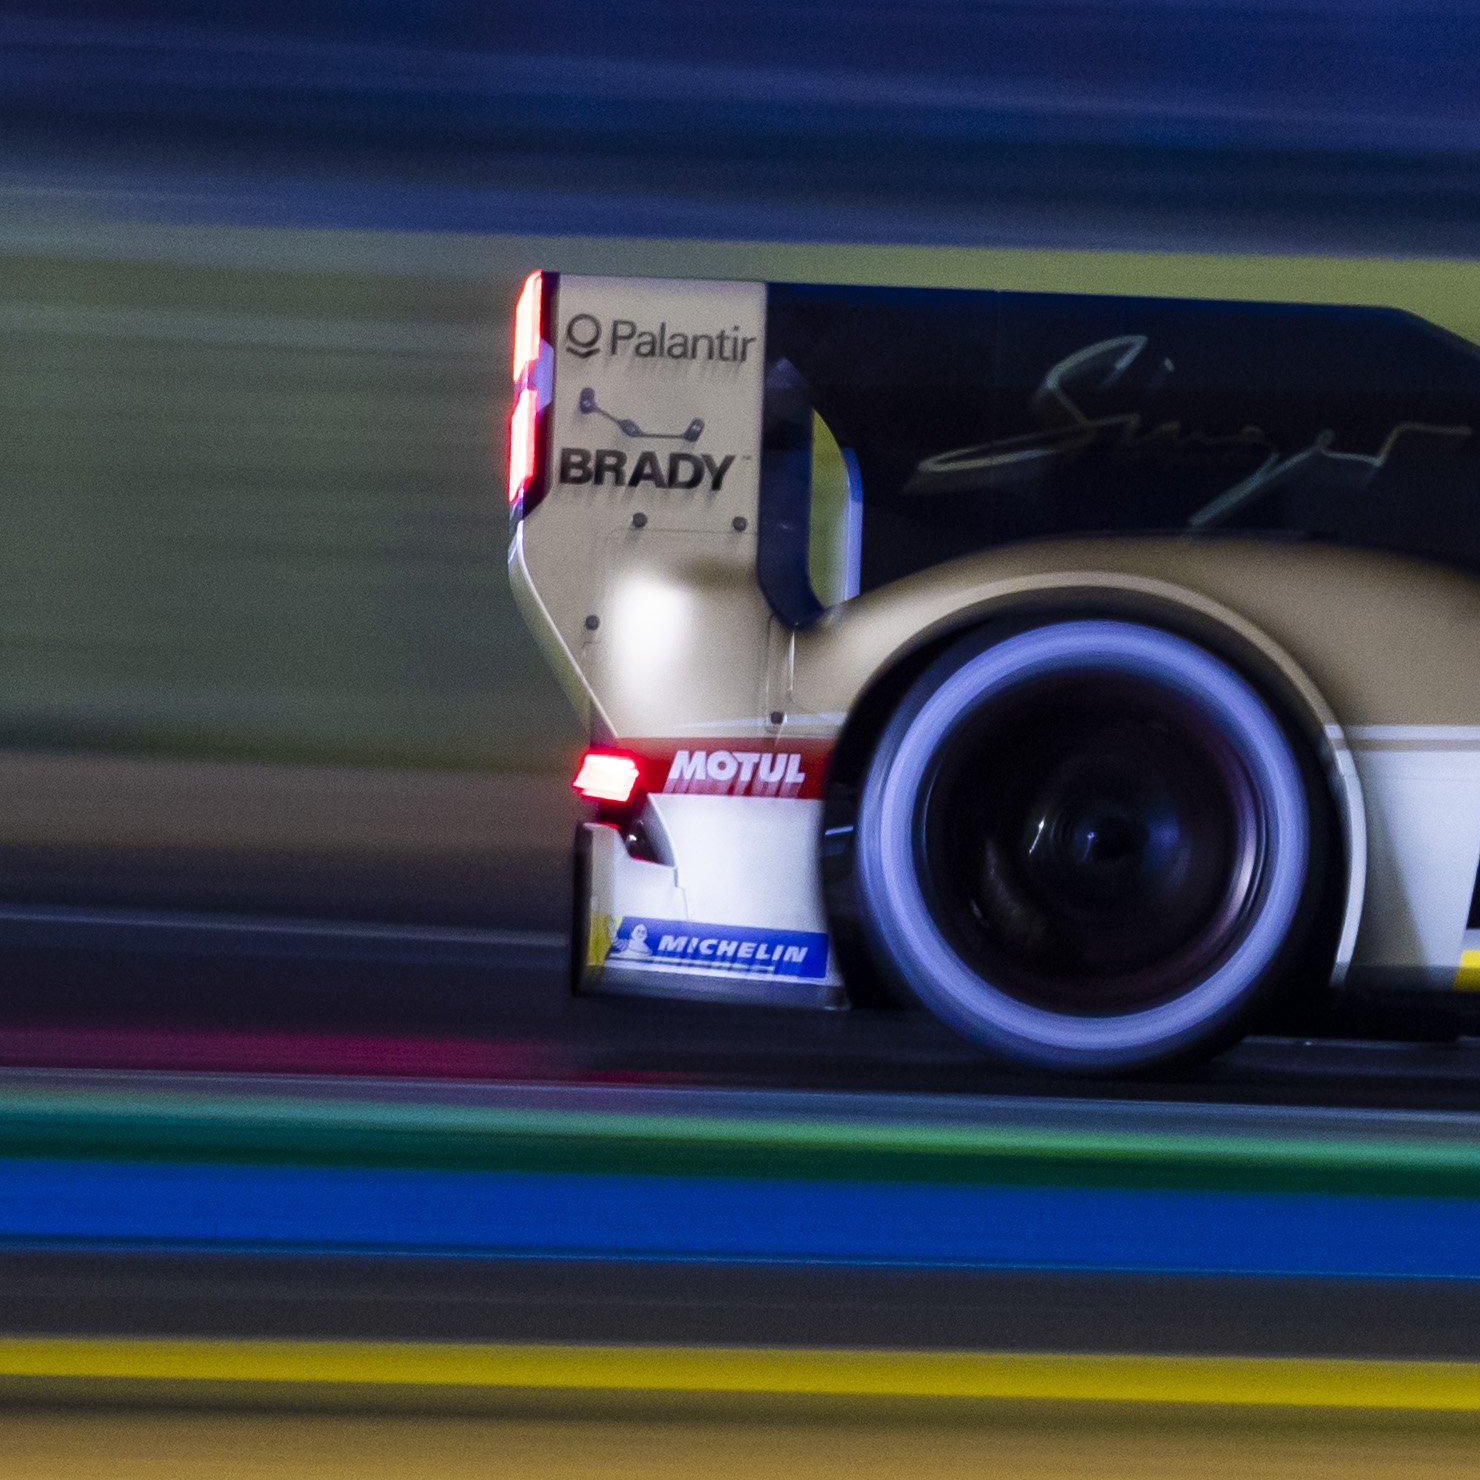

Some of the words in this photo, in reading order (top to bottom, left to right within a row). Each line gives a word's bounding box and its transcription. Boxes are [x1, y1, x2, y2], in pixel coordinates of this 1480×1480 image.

[609, 318, 757, 364] Palantir
[559, 448, 736, 491] BRADY
[668, 750, 805, 783] MOTUL
[658, 935, 808, 962] MICHELIN
